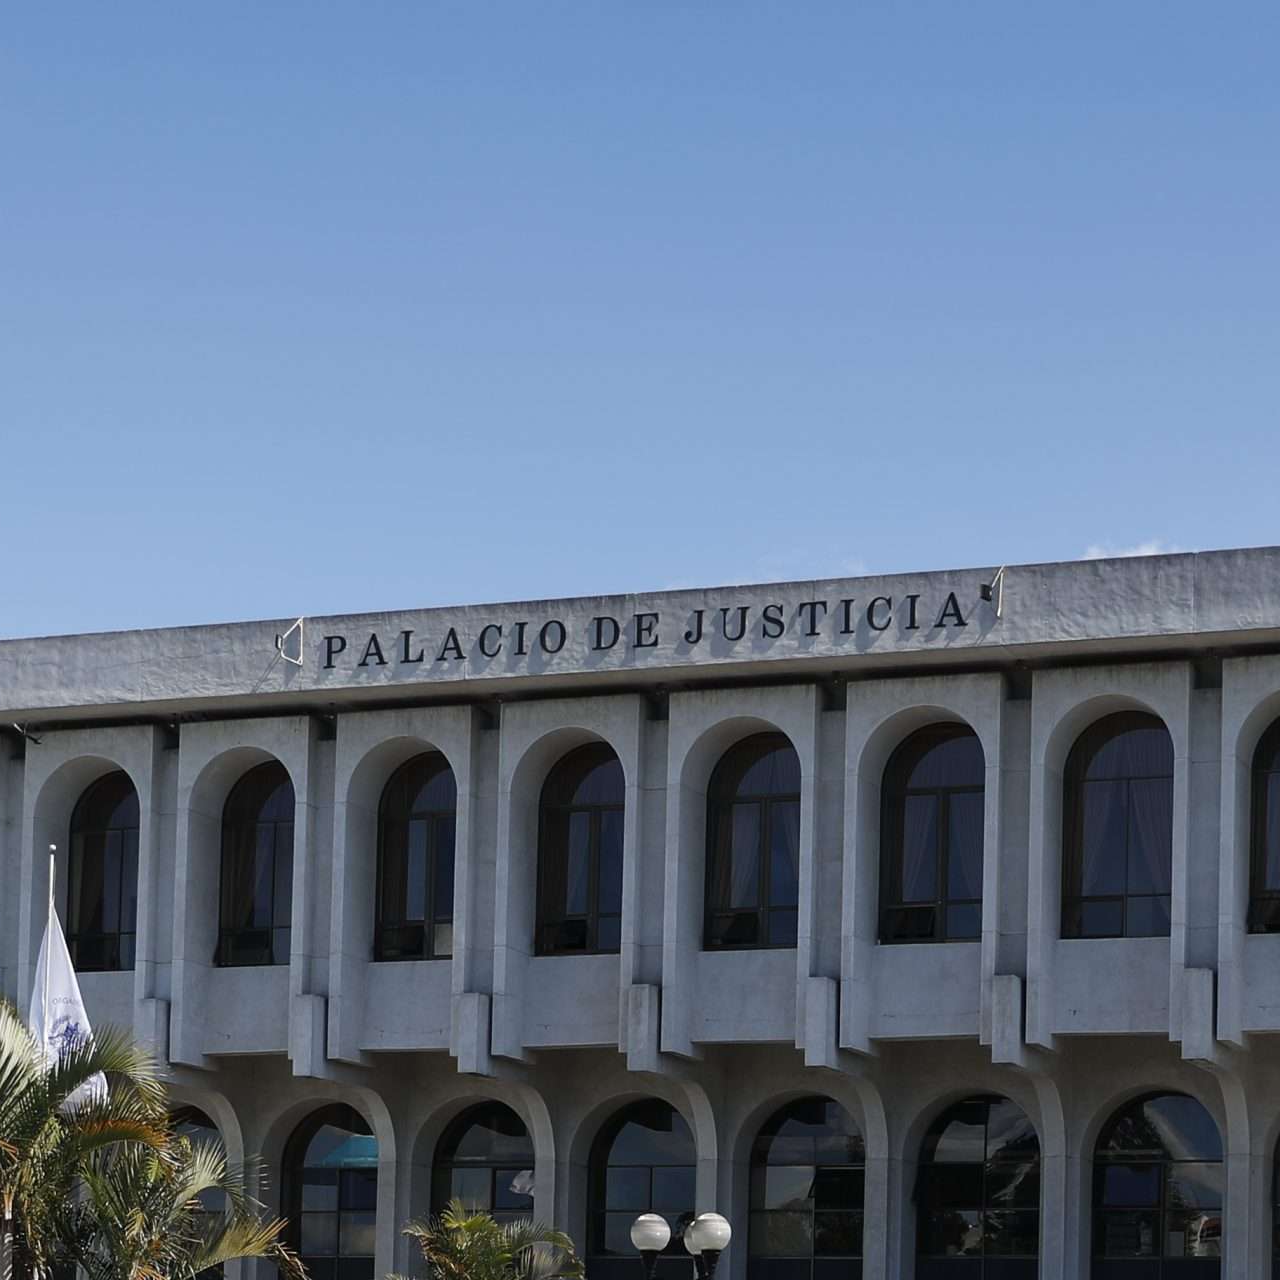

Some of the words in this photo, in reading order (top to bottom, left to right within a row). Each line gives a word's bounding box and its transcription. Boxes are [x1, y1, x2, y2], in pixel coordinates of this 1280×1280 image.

[322, 619, 567, 670] PALACIO
[591, 612, 659, 651] DE
[683, 590, 969, 645] JUSTICIA
